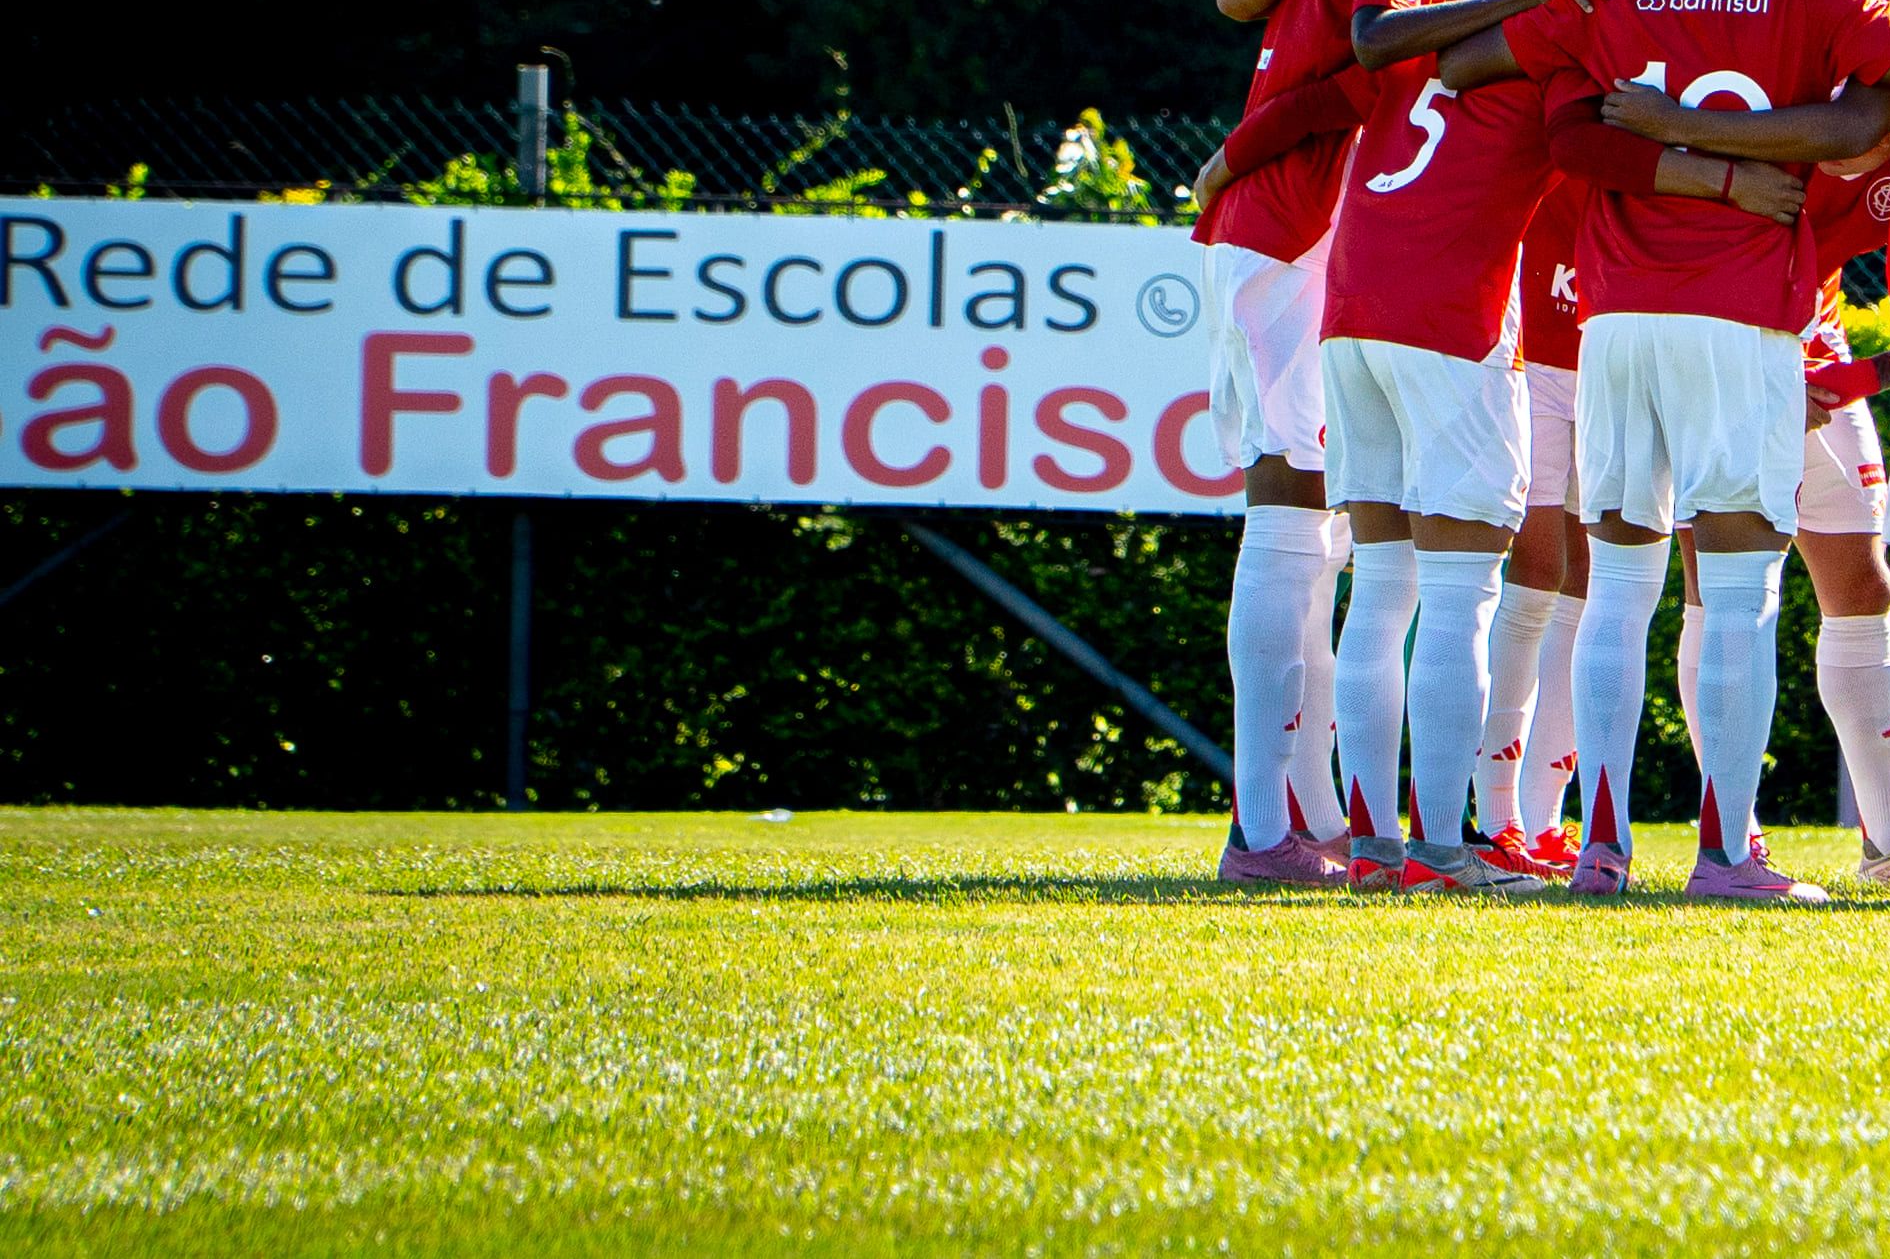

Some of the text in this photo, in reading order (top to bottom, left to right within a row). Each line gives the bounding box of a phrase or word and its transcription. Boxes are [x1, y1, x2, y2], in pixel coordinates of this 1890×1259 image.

[1365, 77, 1458, 194] 5
[0, 212, 1100, 334] Rede de Escolas
[0, 324, 280, 474] ão
